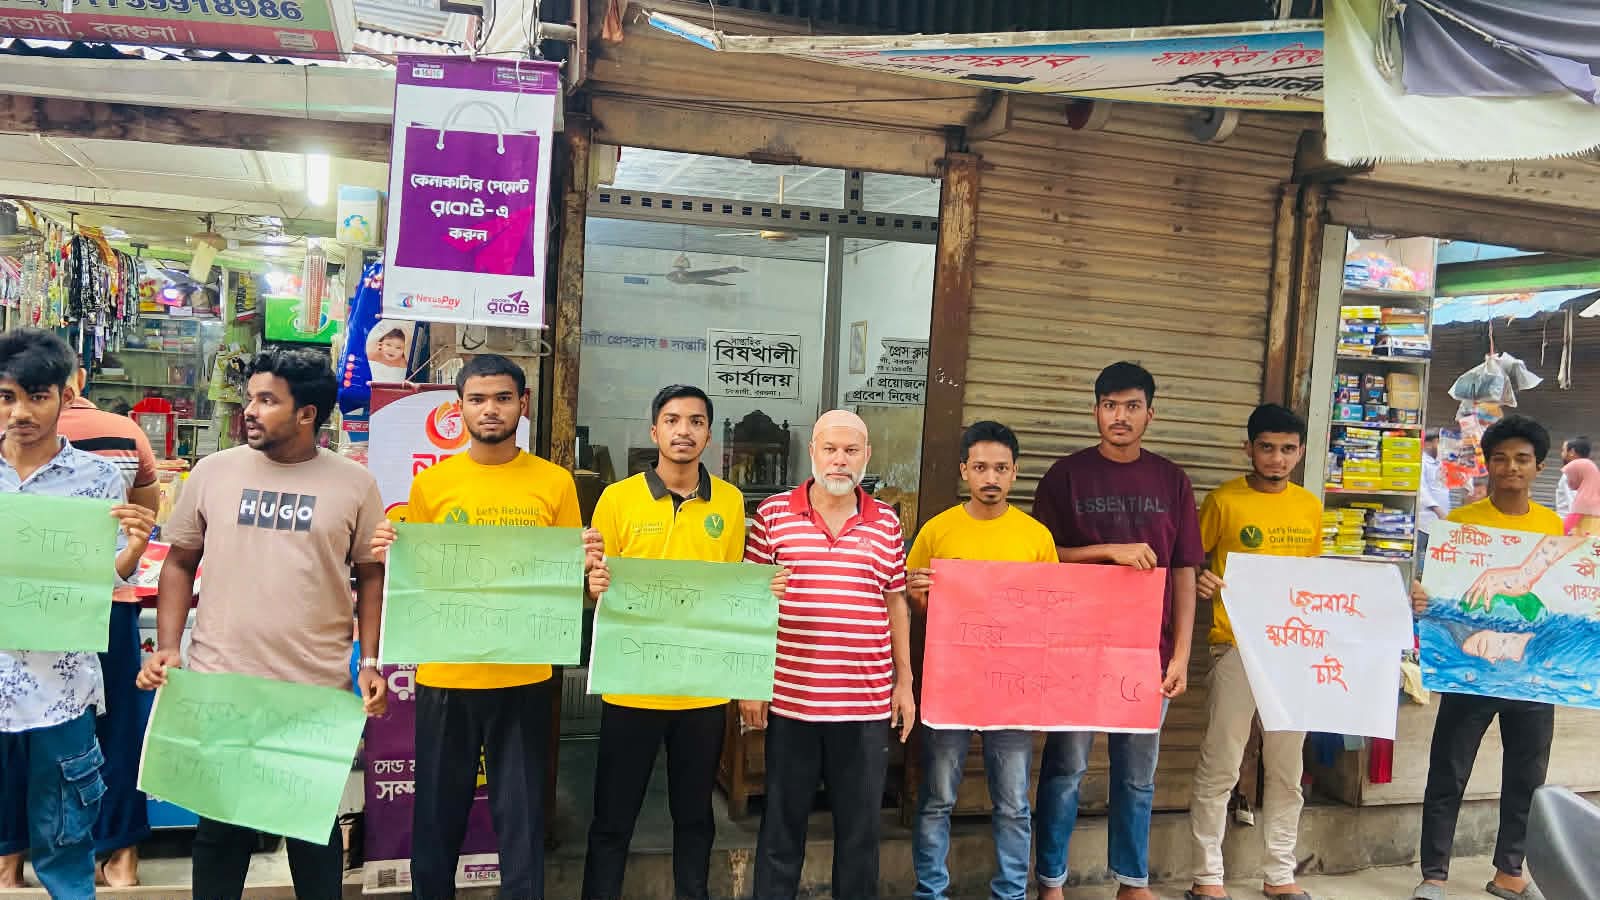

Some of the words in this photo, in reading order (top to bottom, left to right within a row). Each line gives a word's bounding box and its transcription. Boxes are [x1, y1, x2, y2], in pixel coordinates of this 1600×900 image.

[410, 173, 484, 192] কেনাকাটার
[487, 179, 530, 195] পেমেন্ট
[430, 198, 509, 219] রকেট-এ
[448, 227, 488, 242] করুন
[416, 293, 461, 308] NexusPay
[487, 299, 529, 315] রকেট
[713, 339, 798, 365] বিষখালী
[888, 345, 909, 358] প্রেস
[716, 368, 793, 387] কার্যালয়
[853, 390, 884, 402] প্রবেশ
[888, 388, 920, 402] নিষেধ
[240, 500, 313, 521] HUGO
[500, 517, 536, 526] Nation
[1309, 655, 1349, 693] চাই
